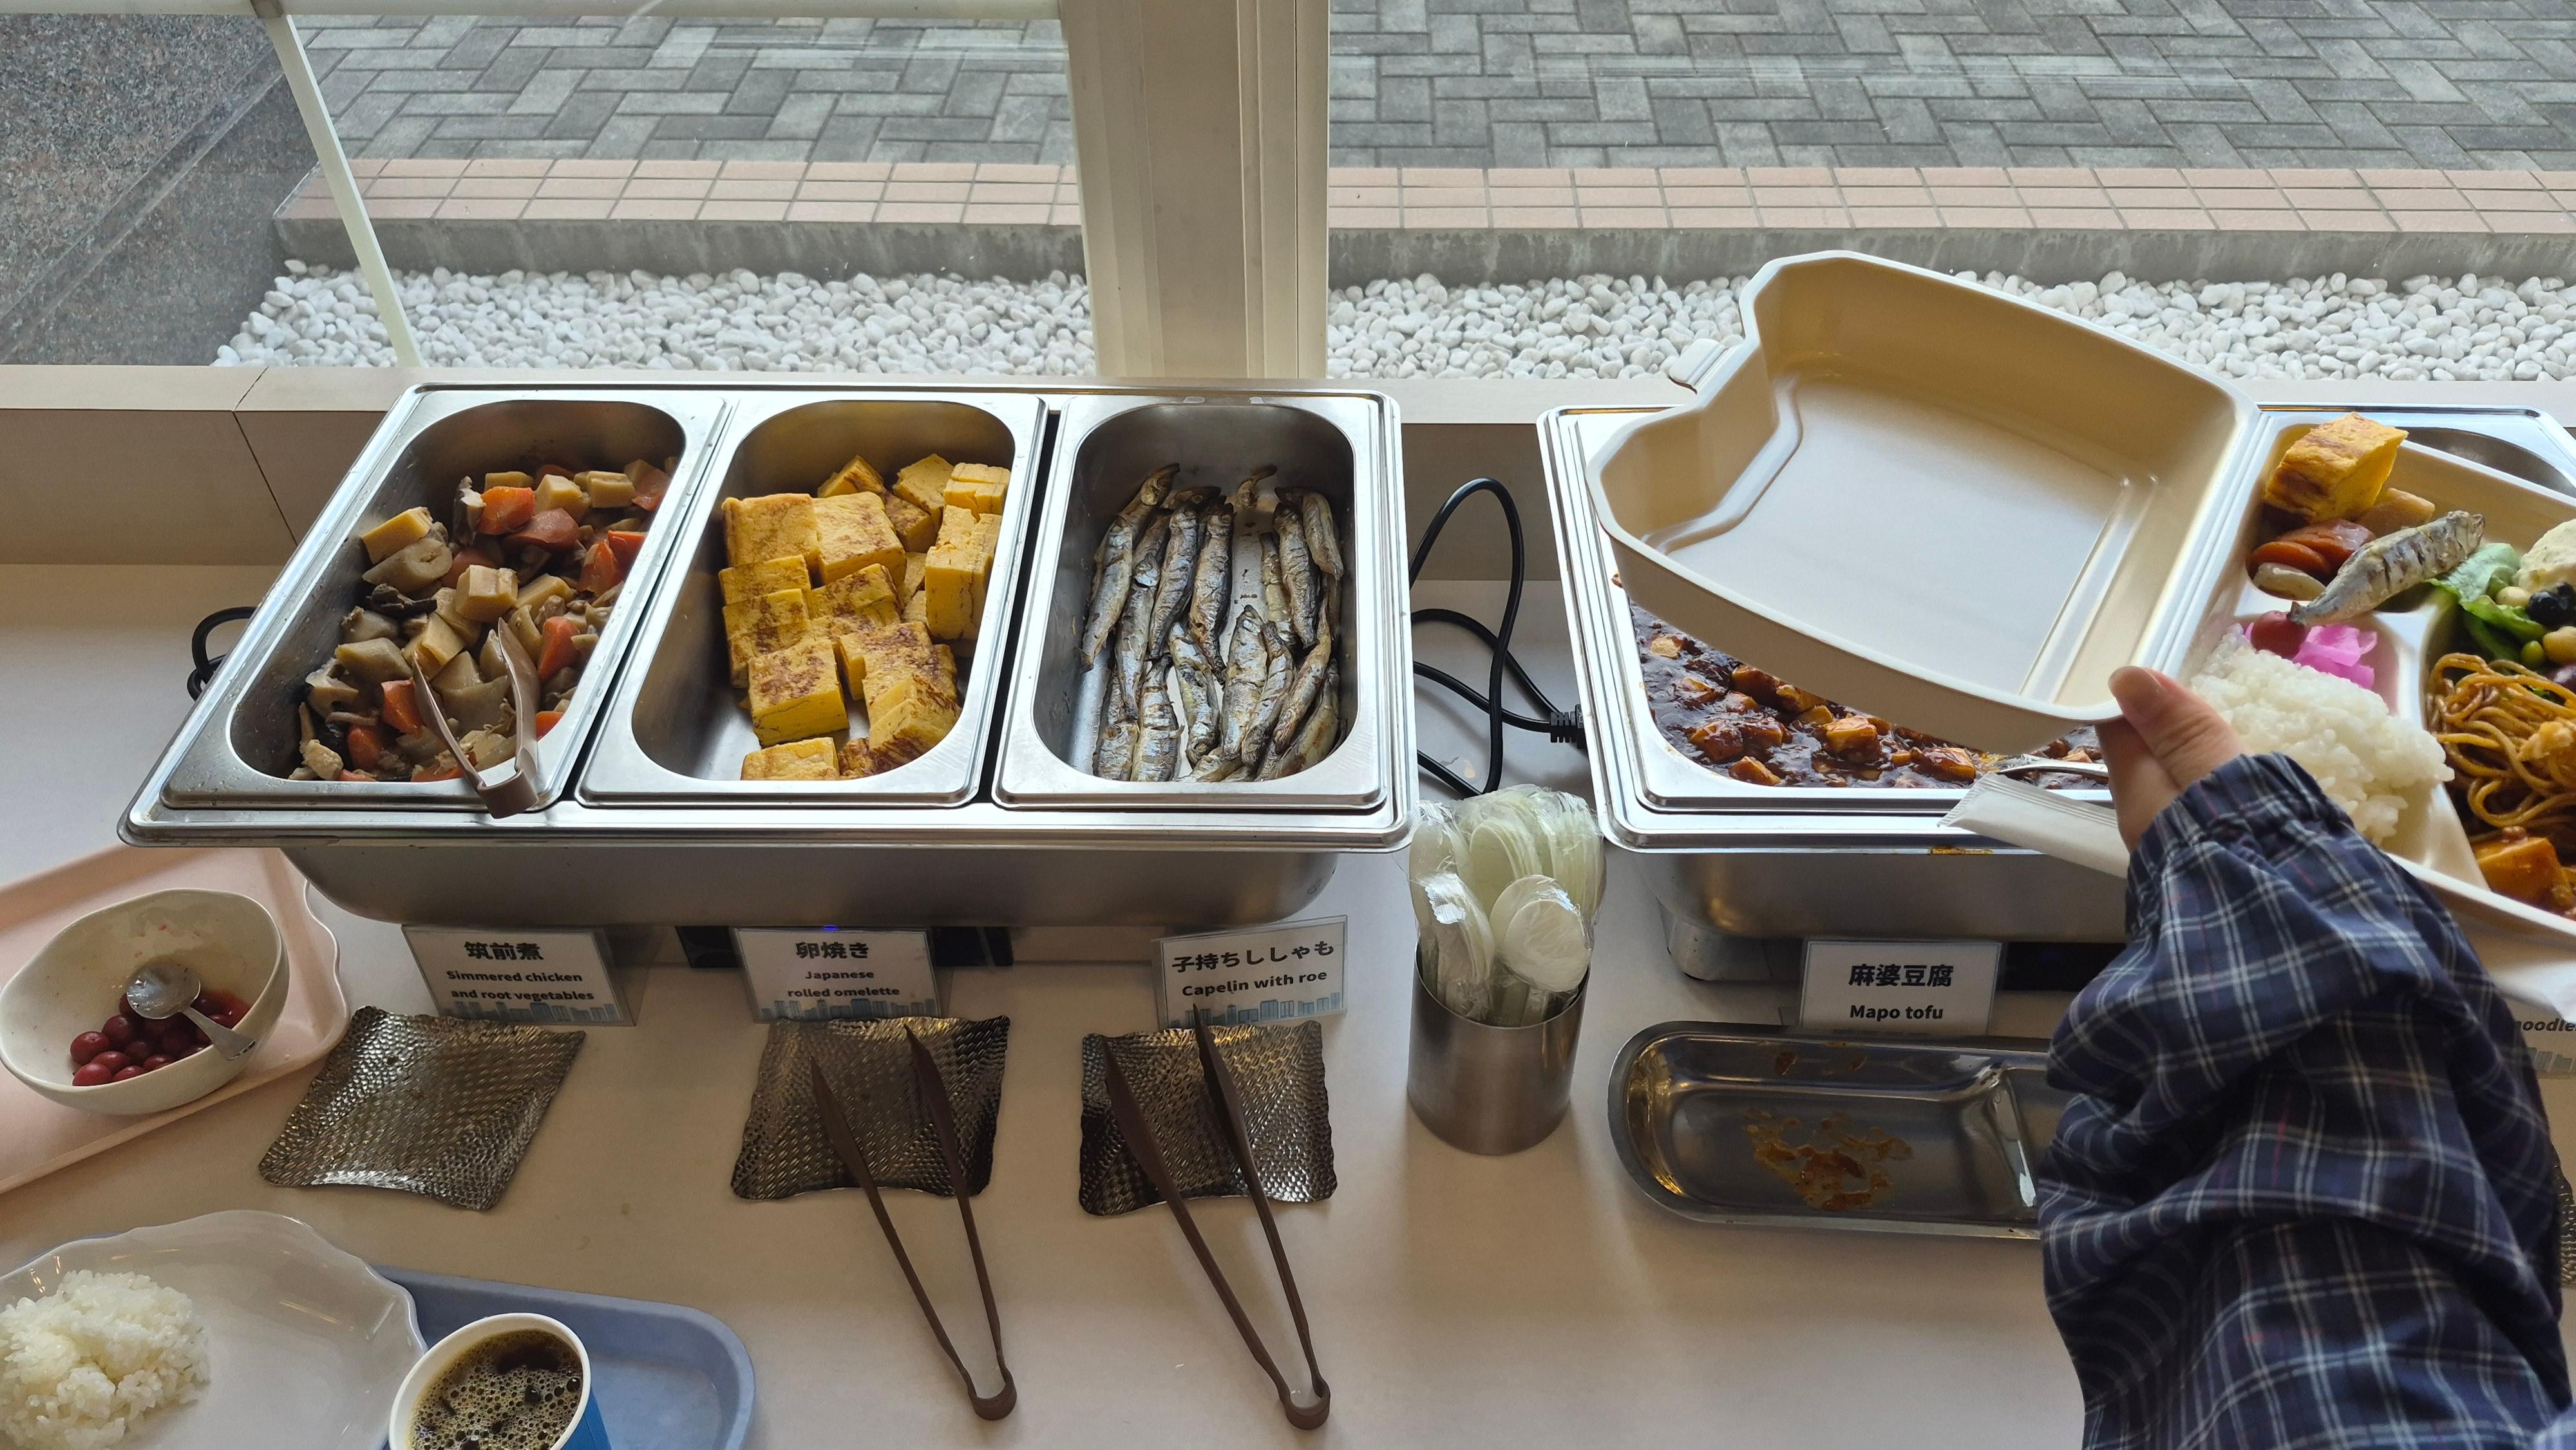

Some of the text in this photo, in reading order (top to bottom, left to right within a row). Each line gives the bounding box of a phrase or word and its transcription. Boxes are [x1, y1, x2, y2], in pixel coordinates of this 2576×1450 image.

[464, 941, 544, 961] 筑前煮
[795, 941, 869, 959] 卵焼き
[1171, 941, 1334, 973] 子持ちししゃも
[447, 970, 582, 983] Simmered chicken
[805, 971, 874, 981] Japanese
[1182, 971, 1327, 997] Capelin with roe
[1848, 964, 1953, 987] 麻婆豆腐
[451, 989, 594, 1002] and root vegetables
[788, 987, 900, 997] rolled omelette
[1850, 1005, 1944, 1022] Mapo tofu
[2514, 1018, 2576, 1031] oodle
